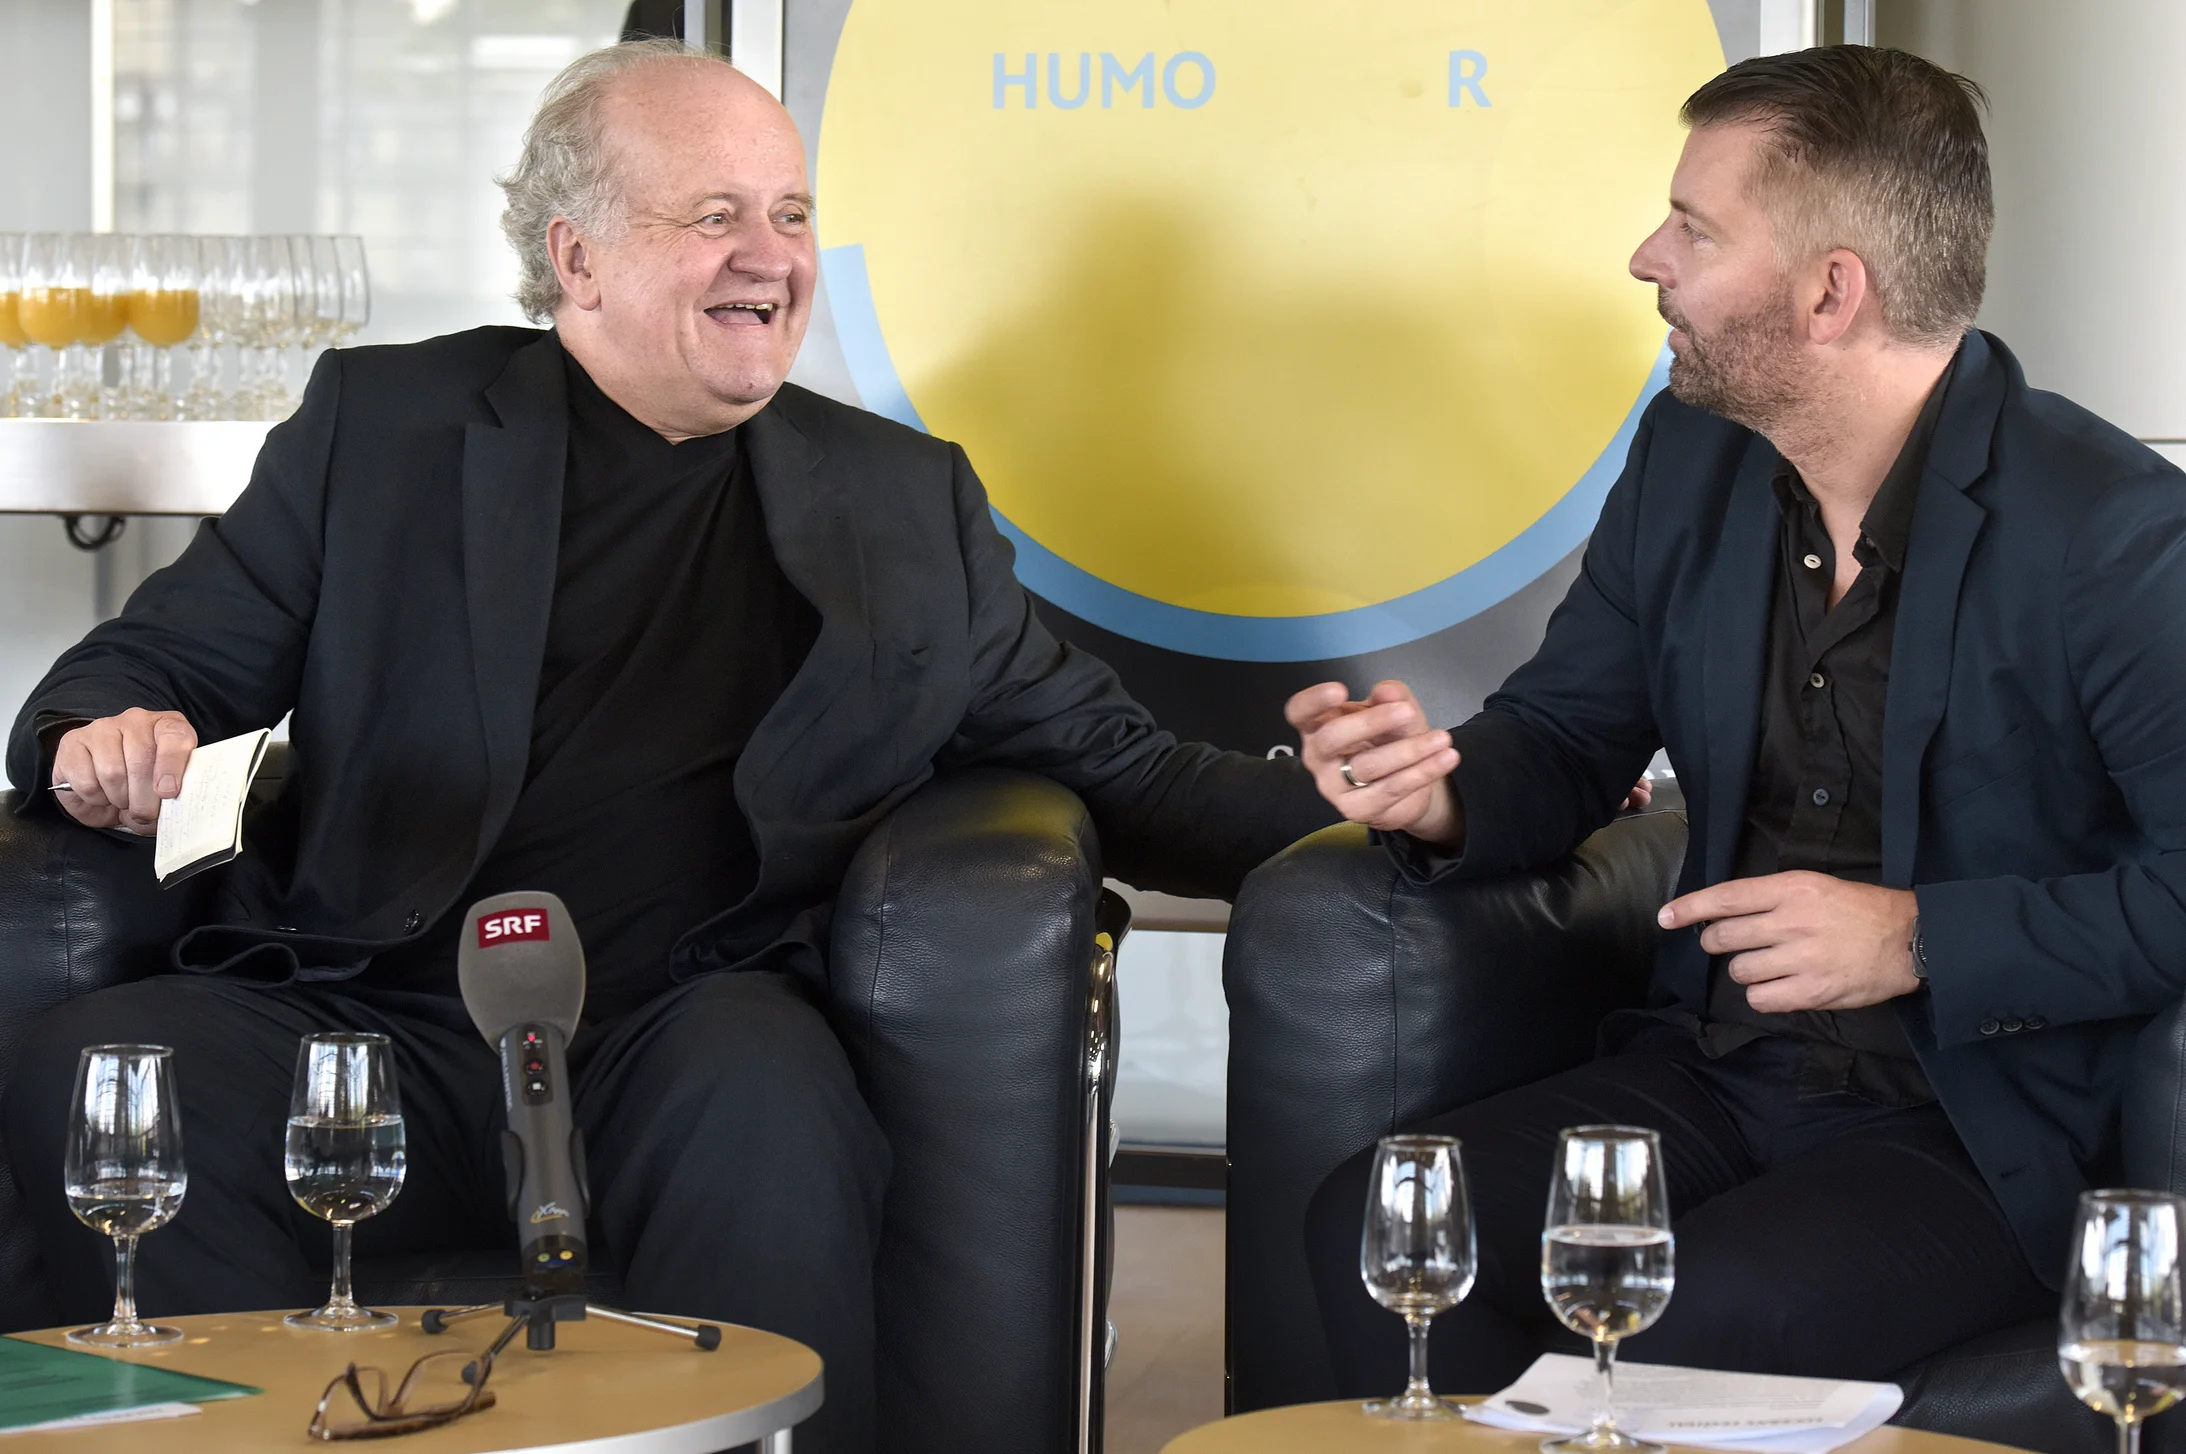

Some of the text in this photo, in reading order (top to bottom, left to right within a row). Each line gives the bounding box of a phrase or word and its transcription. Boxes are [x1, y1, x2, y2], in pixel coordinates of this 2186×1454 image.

[992, 50, 1492, 109] HUMO R
[484, 914, 542, 940] SRF
